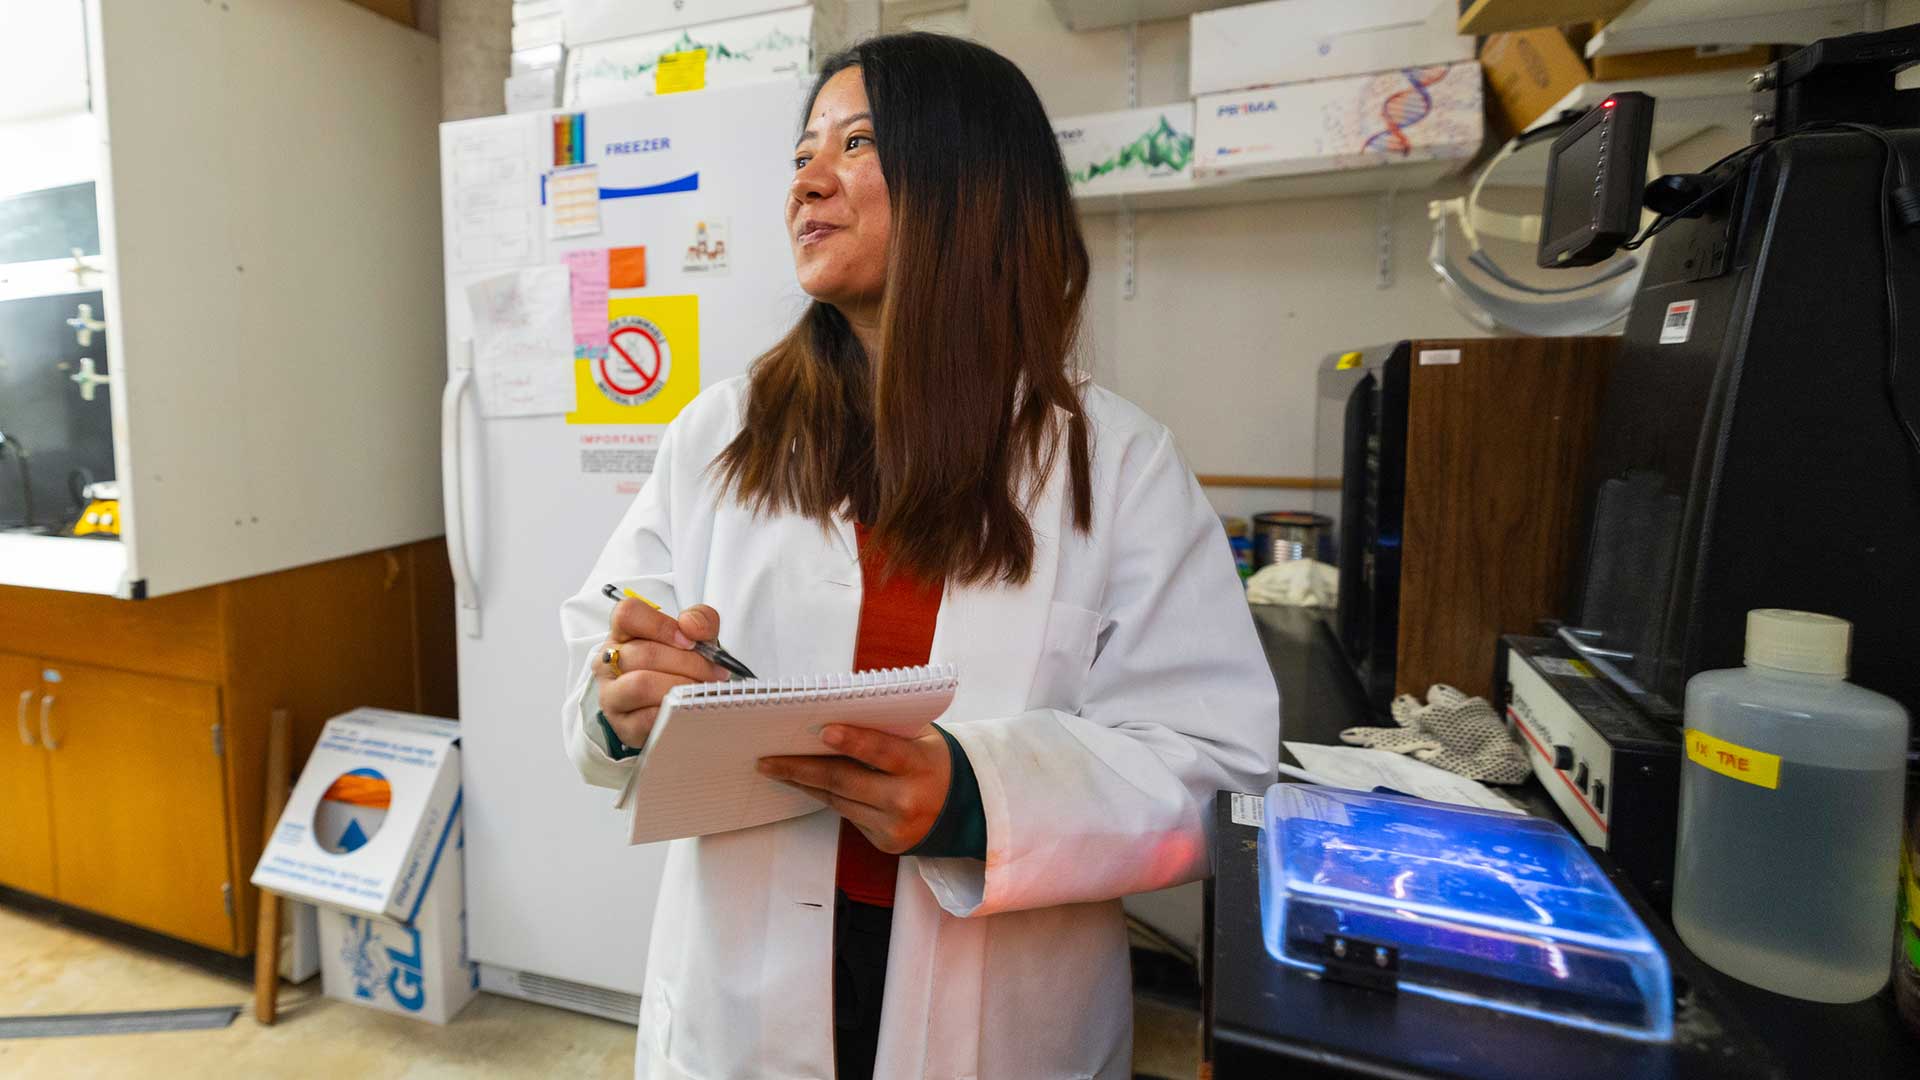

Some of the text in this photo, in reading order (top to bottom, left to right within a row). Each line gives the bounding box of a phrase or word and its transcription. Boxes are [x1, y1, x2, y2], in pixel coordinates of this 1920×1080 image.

[605, 137, 671, 156] FREEZER
[1716, 751, 1750, 772] TAE
[385, 926, 425, 1011] GL
